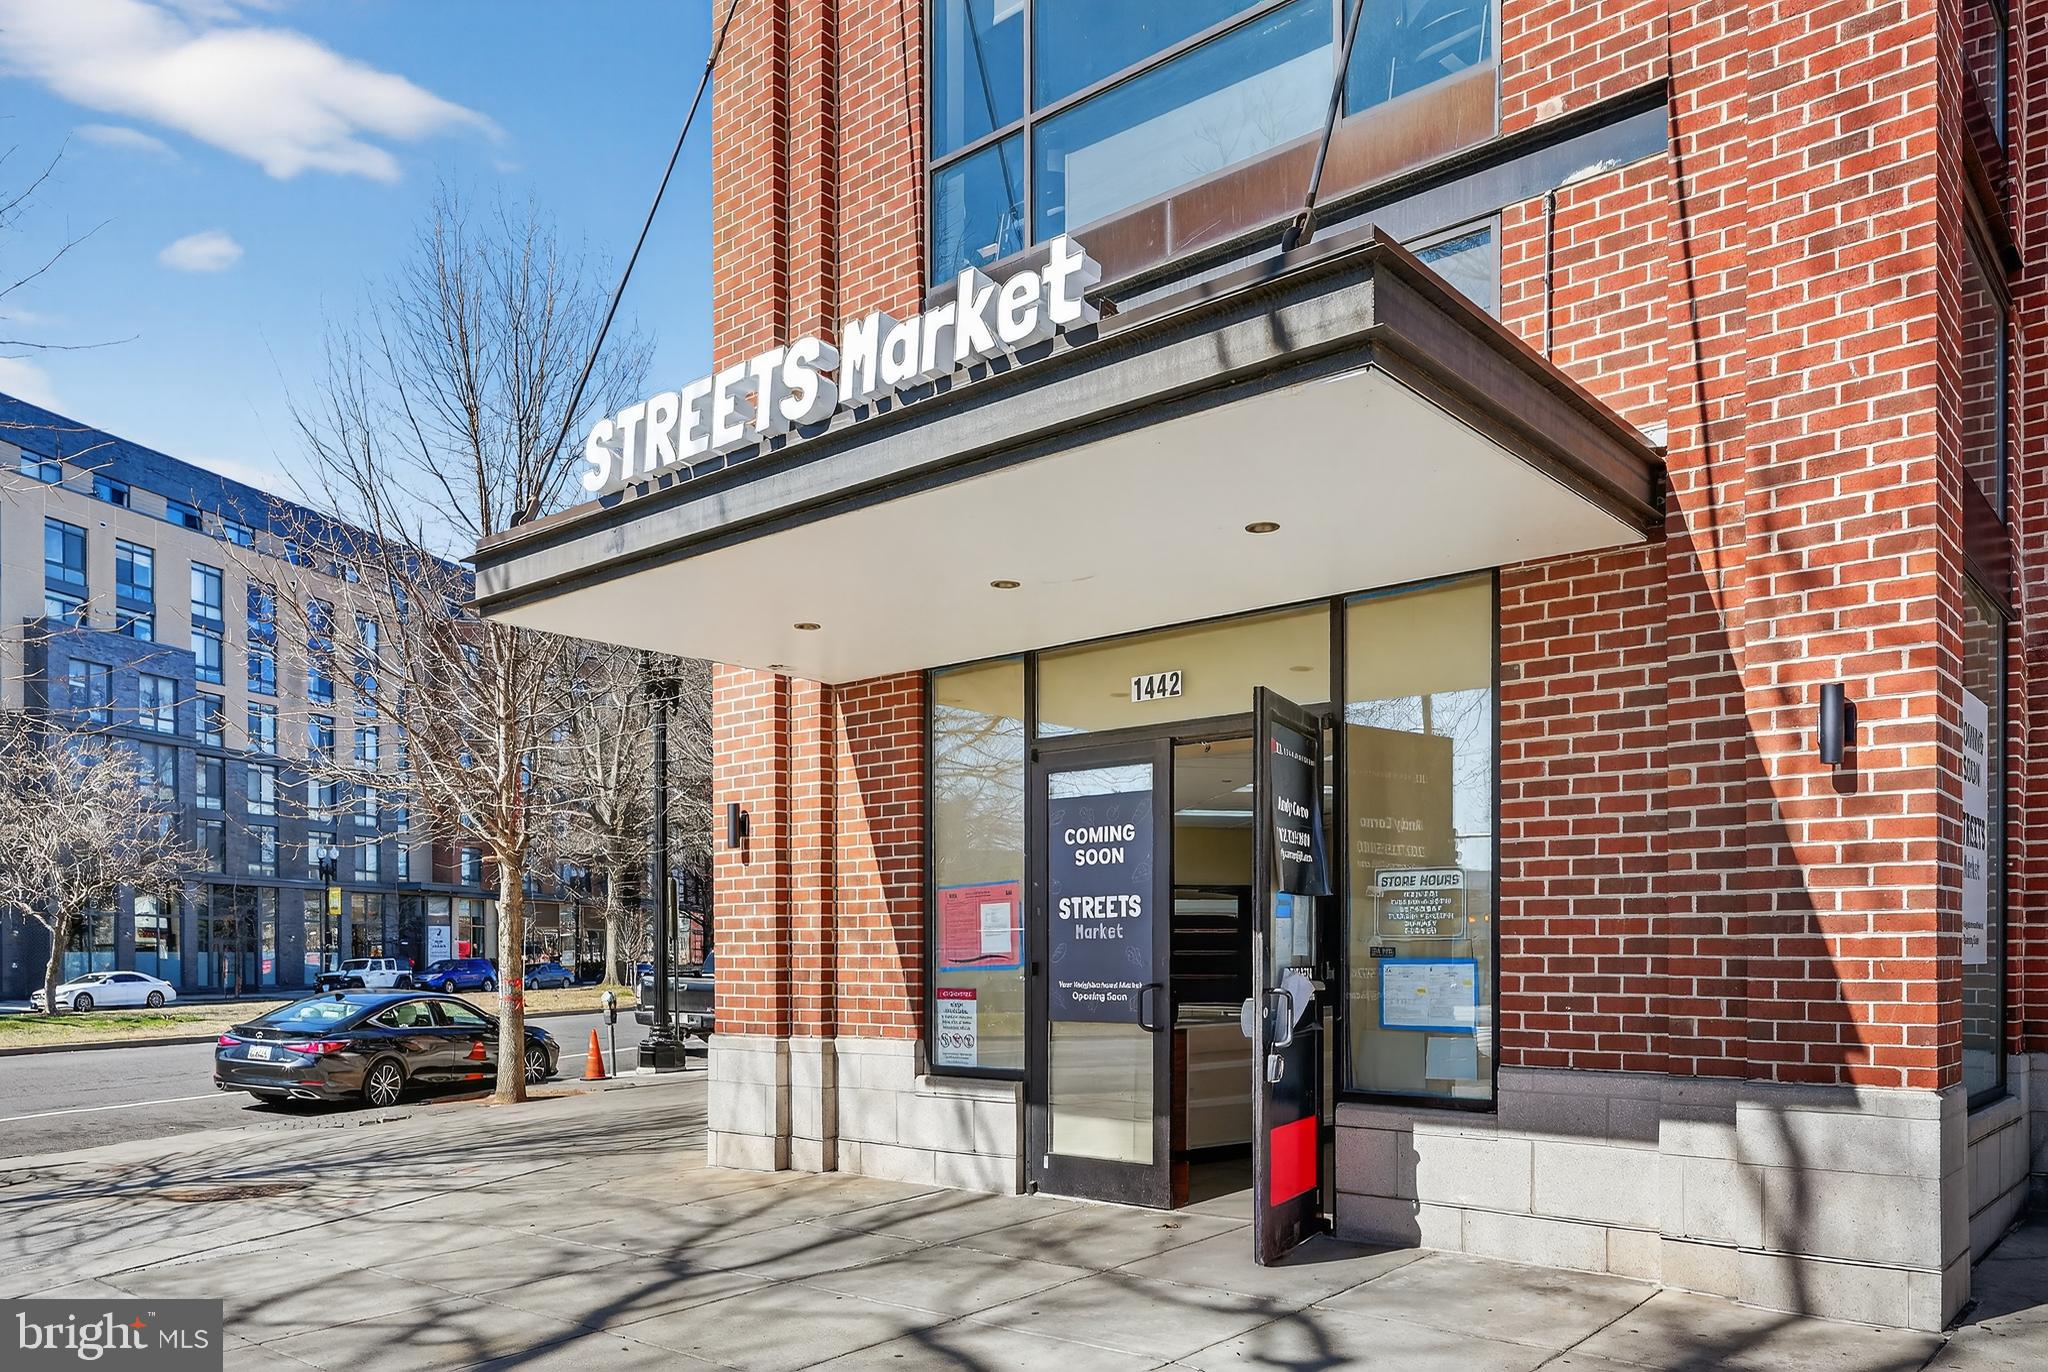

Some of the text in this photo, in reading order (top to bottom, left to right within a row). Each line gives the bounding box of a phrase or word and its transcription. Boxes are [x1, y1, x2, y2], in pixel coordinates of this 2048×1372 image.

[582, 234, 1101, 493] STREETS Market
[1133, 671, 1180, 701] 1442
[1963, 721, 1984, 756] OMING
[1064, 823, 1136, 845] COMING
[1075, 847, 1125, 866] SOON
[1381, 874, 1460, 887] STORE HOURS
[1058, 894, 1142, 920] STREETS
[1075, 922, 1124, 940] Market
[1106, 991, 1128, 1002] Soon
